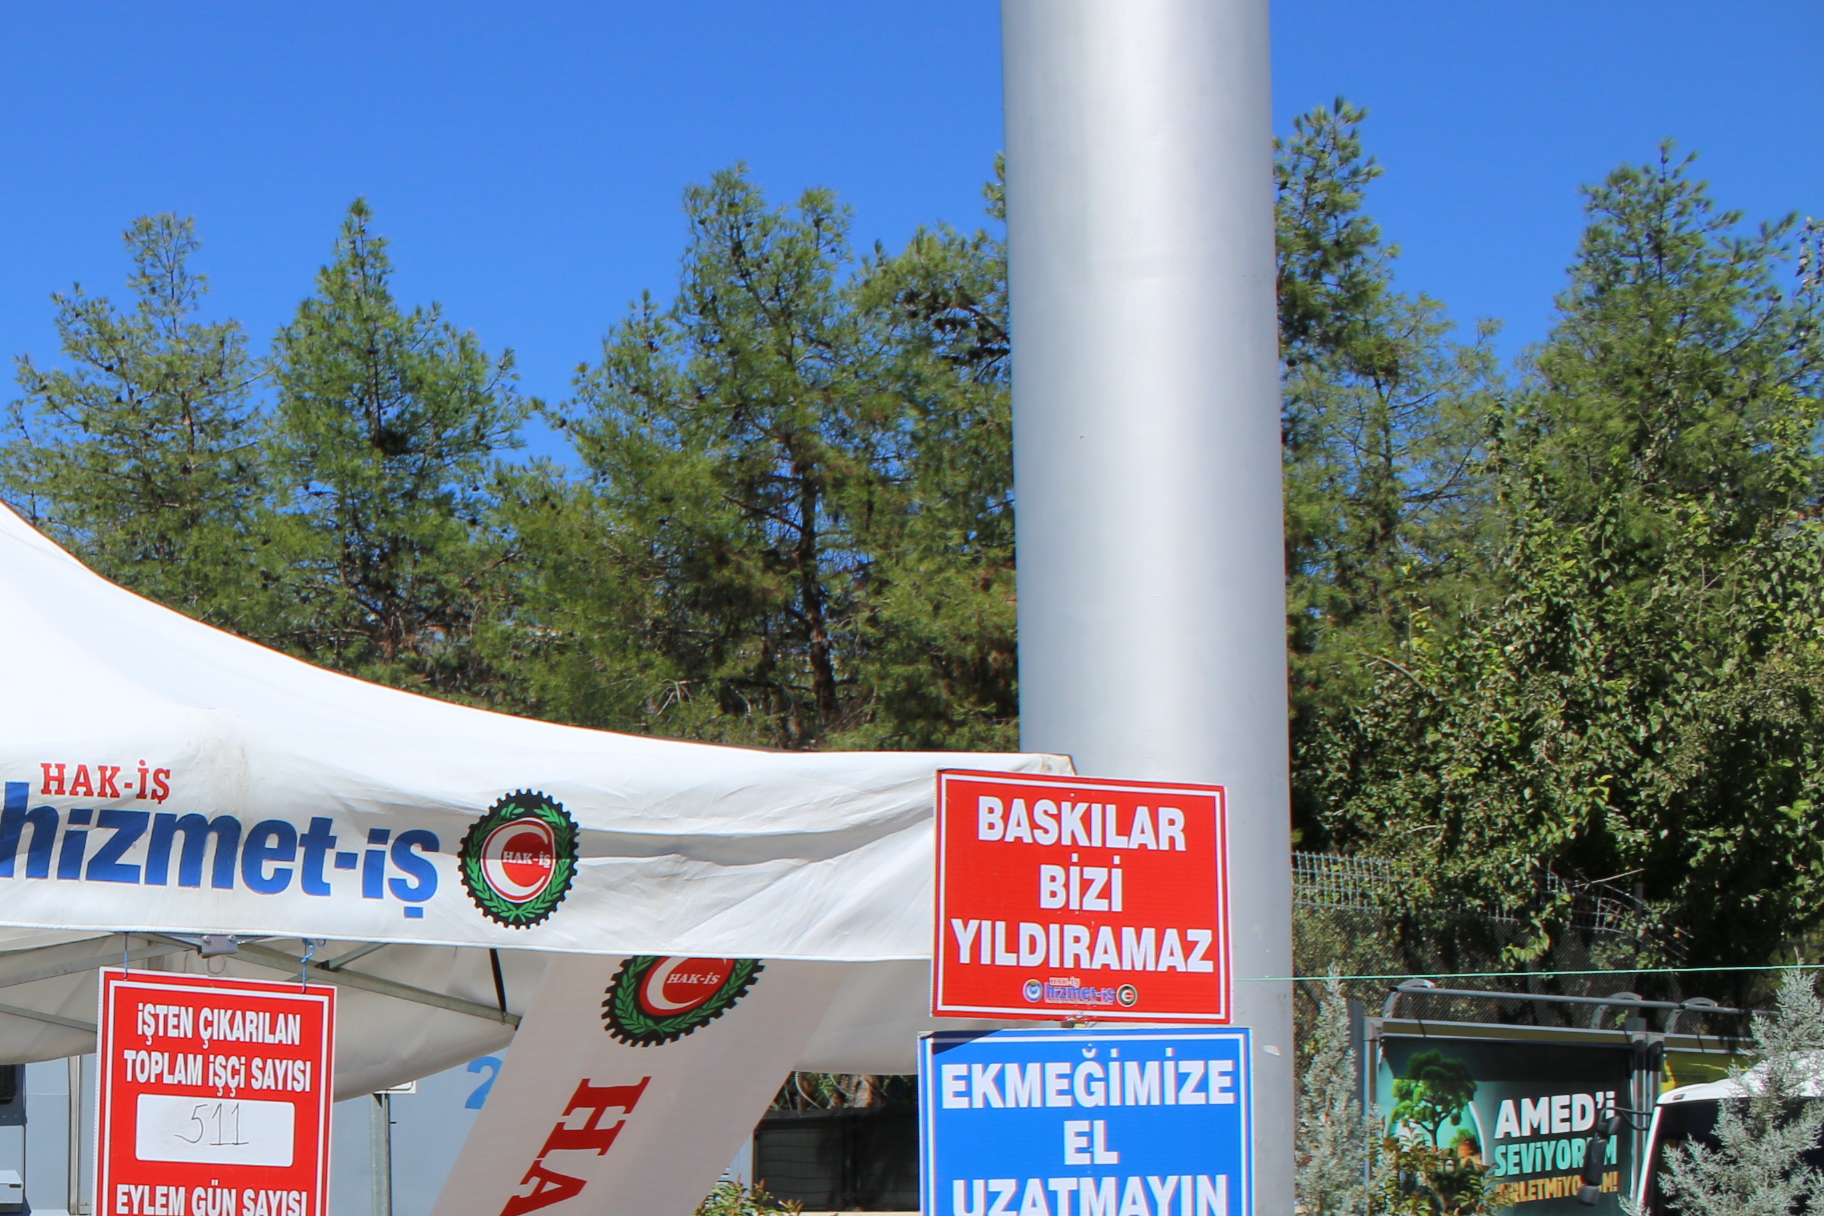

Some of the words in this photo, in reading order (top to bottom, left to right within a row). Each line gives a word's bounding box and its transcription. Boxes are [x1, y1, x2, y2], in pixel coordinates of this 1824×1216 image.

[40, 760, 171, 804] HAK-İŞ
[977, 796, 1186, 851] BASKILAR
[1039, 853, 1123, 912] BİZİ
[951, 918, 1214, 974] YILDIRAMAZ
[200, 1006, 302, 1049] ÇIKARILAN
[124, 1050, 203, 1088] TOPLAM
[251, 1057, 311, 1093] SAYISI
[941, 1044, 1235, 1110] EKMEĞİMİZE
[174, 1103, 249, 1146] 511
[1064, 1120, 1119, 1165] EL
[116, 1184, 186, 1216] EYLEM
